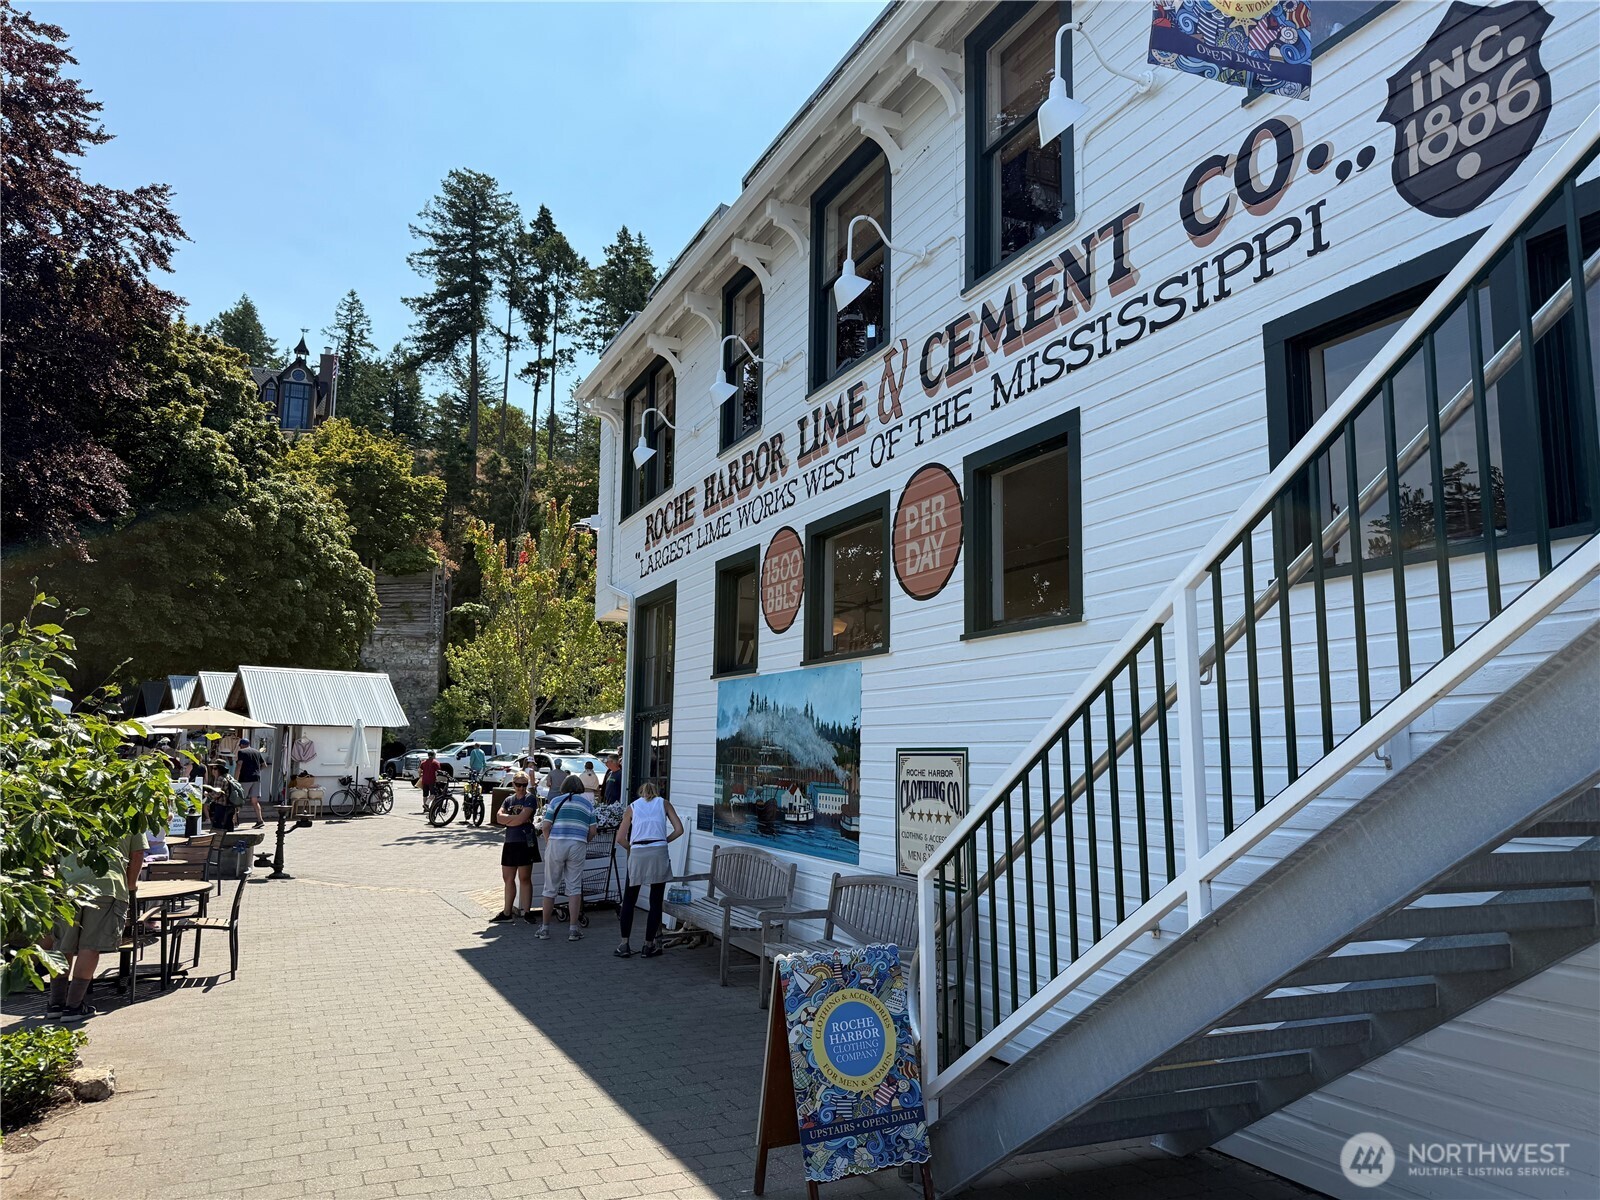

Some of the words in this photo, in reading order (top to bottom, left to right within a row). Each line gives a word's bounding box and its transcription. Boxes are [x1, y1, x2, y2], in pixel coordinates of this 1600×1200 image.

[1235, 3, 1243, 12] &
[1246, 0, 1273, 13] WOM
[1196, 43, 1233, 61] OPEN
[1235, 53, 1272, 72] DAILY
[1411, 25, 1526, 107] INC.
[1403, 60, 1540, 177] 1886
[645, 486, 697, 551] ROCHE
[703, 432, 789, 518] HARBOR
[797, 380, 870, 468] LIME
[919, 202, 1145, 397] CEMENT
[696, 512, 732, 549] LIME
[737, 479, 798, 529] WORKS
[803, 447, 859, 498] WEST
[870, 423, 903, 468] OF
[909, 387, 973, 447] THE
[905, 495, 947, 539] PER
[764, 549, 801, 585] 1500
[905, 531, 946, 576] DAY
[906, 769, 926, 777] ROCHE
[928, 769, 954, 778] HARBOR
[900, 780, 946, 814] CLOTHING
[947, 781, 962, 817] CO.
[901, 831, 923, 841] CLOTHING
[925, 844, 935, 852] FOR
[907, 850, 921, 861] MEN
[815, 996, 841, 1039] CLOTHING
[849, 992, 892, 1029] ACCESSORIES
[831, 1016, 875, 1033] ROCHE
[829, 1027, 880, 1045] HARBOR
[833, 1039, 879, 1054] CLOTHING
[823, 1063, 838, 1081] FOR
[839, 1077, 859, 1088] MEN
[861, 1079, 867, 1087] &
[868, 1052, 893, 1083] WOMEN
[836, 1048, 878, 1063] COMPANY
[809, 1122, 856, 1139] UPSTAIRS
[862, 1116, 890, 1129] OPEN
[890, 1109, 919, 1123] DAILY
